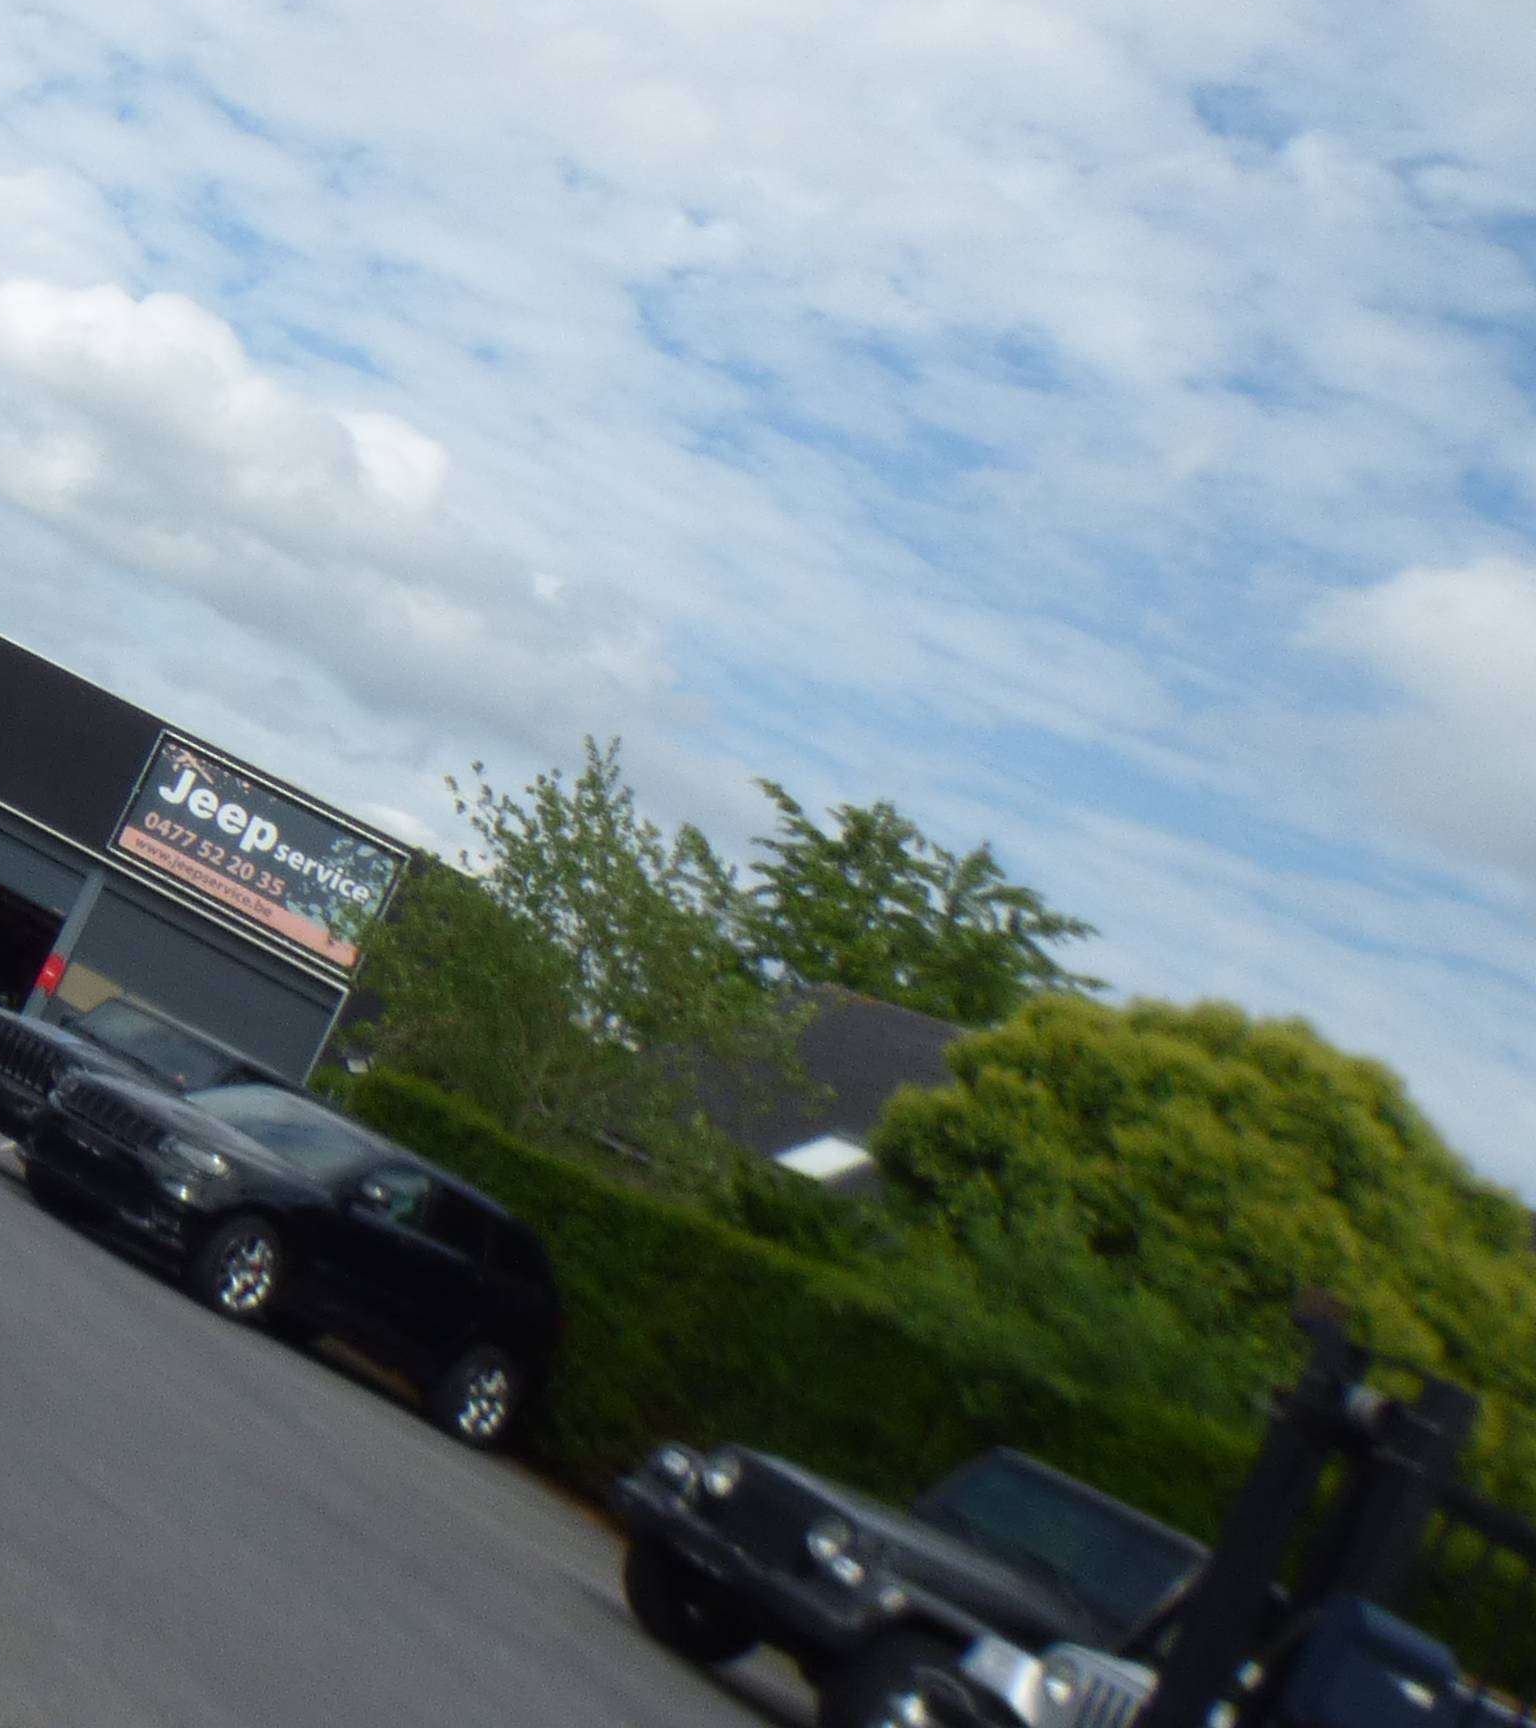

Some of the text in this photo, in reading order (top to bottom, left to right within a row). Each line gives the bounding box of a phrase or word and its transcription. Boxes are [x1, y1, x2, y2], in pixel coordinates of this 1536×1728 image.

[144, 811, 286, 897] 0477 52 20 35
[157, 768, 372, 905] Jeep service
